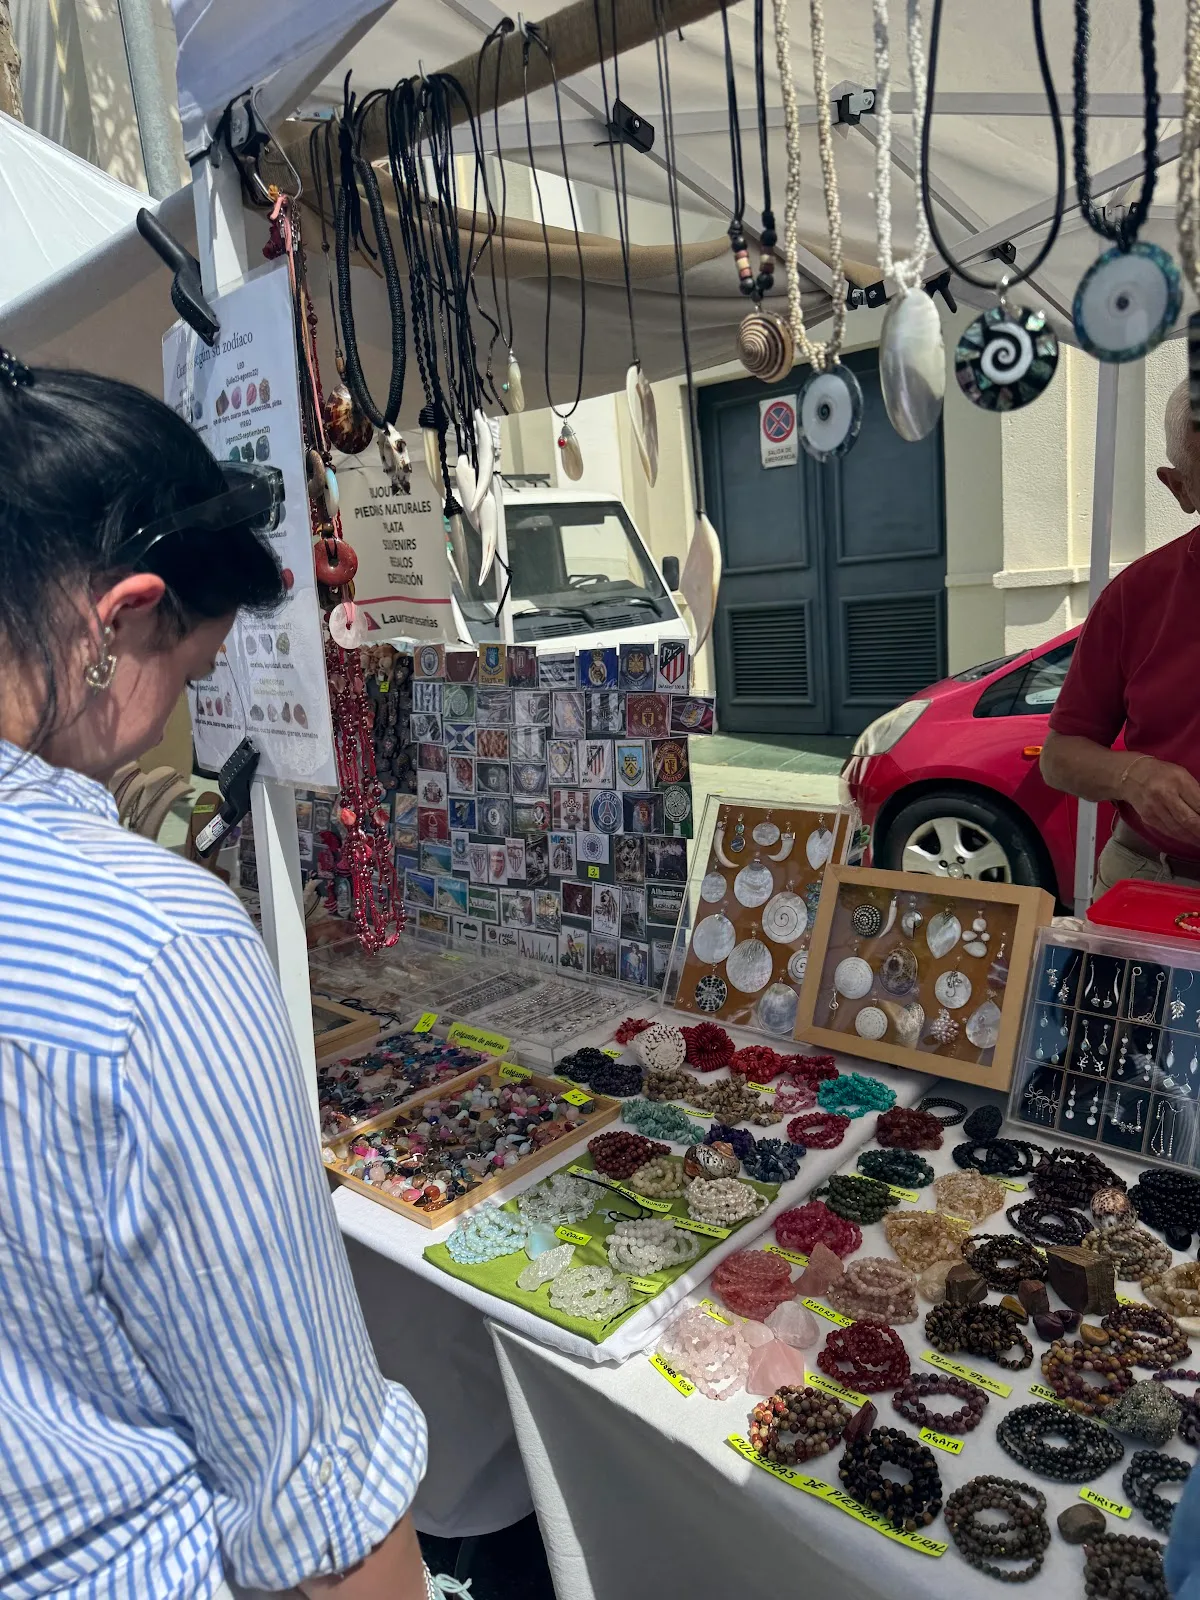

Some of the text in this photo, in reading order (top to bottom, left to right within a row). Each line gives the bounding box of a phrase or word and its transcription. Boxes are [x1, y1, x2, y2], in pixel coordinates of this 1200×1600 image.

[222, 331, 253, 354] zodíaco
[385, 500, 432, 515] NATURALES
[382, 521, 404, 533] PLATA
[597, 792, 618, 805] PARIS
[453, 1029, 477, 1042] Colgantes
[484, 1039, 505, 1050] piedras
[951, 1365, 966, 1374] de
[808, 1374, 860, 1402] Cornalina
[731, 1436, 949, 1554] PULSERAS DE PIEDRA NATURAL
[1086, 1490, 1124, 1514] PIRITA
